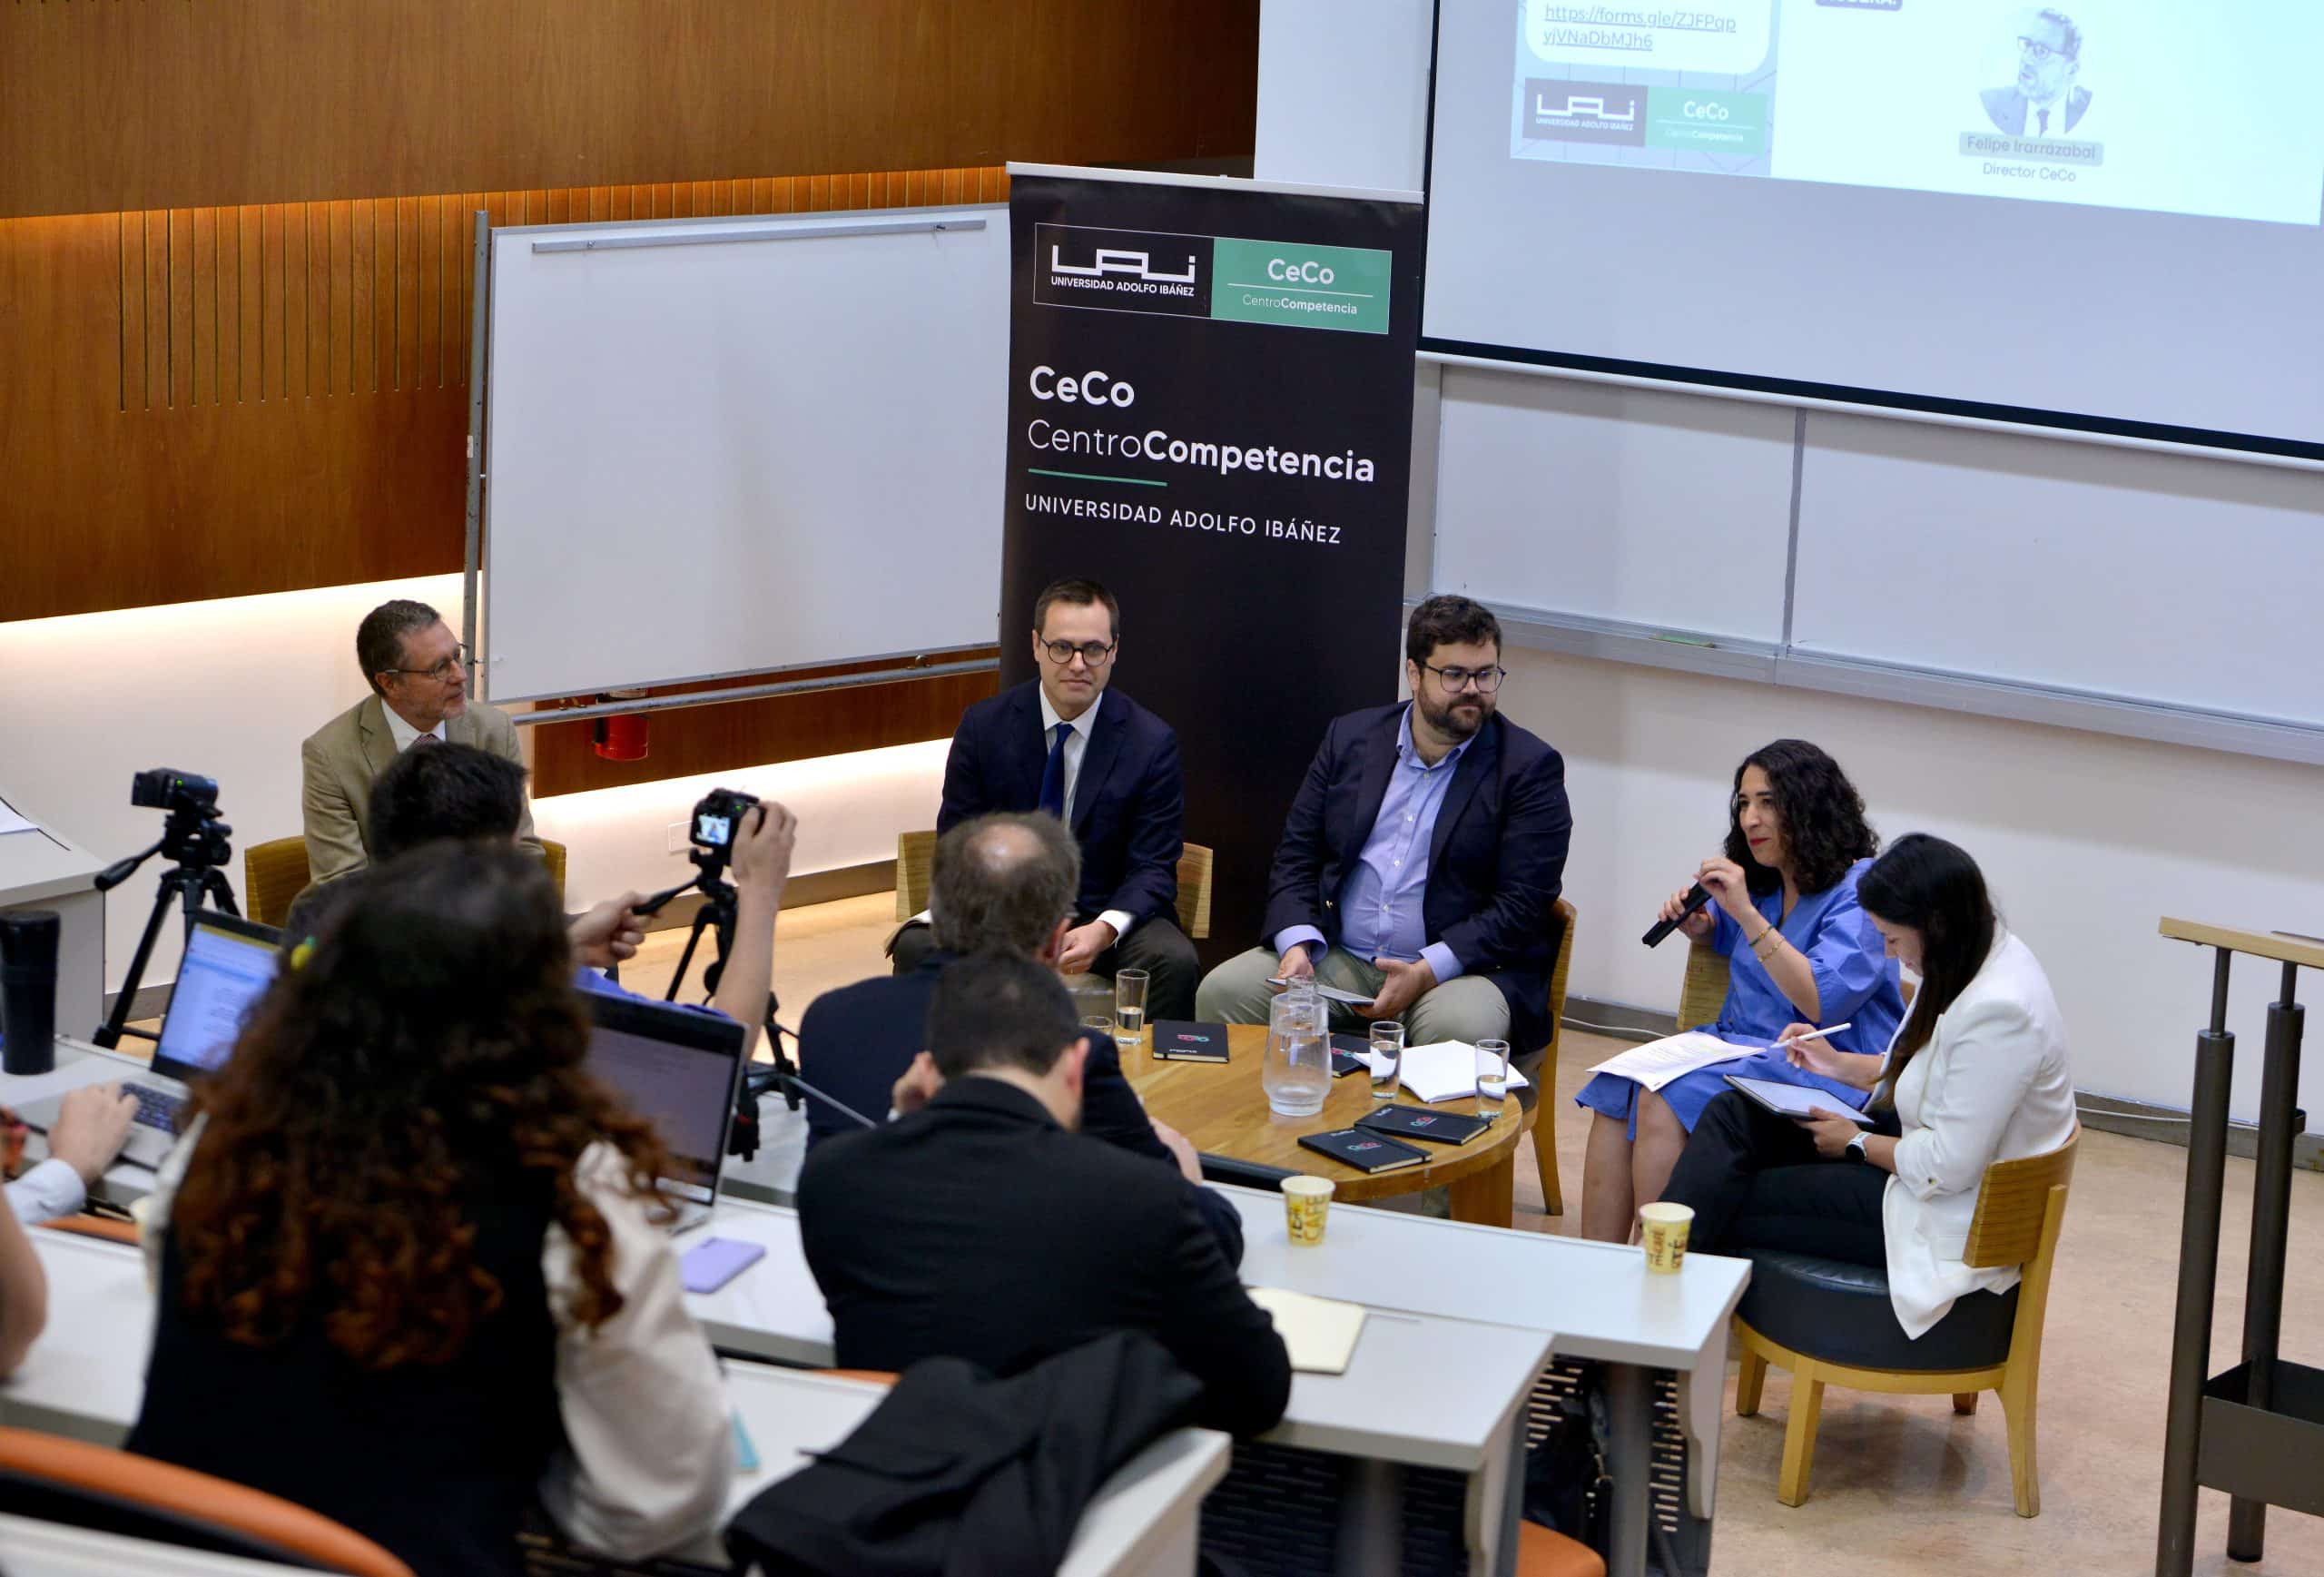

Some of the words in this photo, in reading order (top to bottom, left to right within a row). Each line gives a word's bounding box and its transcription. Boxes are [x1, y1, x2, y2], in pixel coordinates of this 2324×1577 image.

[1684, 101, 1729, 120] CeCo
[1967, 135, 2010, 153] Felipe
[1983, 162, 2035, 179] Director
[2039, 167, 2076, 182] CeCo
[1267, 258, 1334, 285] CeCo
[1050, 275, 1115, 291] UNIVERSIDAD
[1116, 281, 1157, 294] ADOLFO
[1159, 282, 1195, 297] IBÁÑEZ
[1242, 293, 1358, 315] CentroCompetencia
[1029, 365, 1135, 408] CeCo
[1028, 419, 1374, 482] CentroCompetencia
[1025, 493, 1162, 524] UNIVERSIDAD
[1169, 508, 1256, 535] ADOLFO
[1265, 517, 1342, 545] IBÁÑEZ
